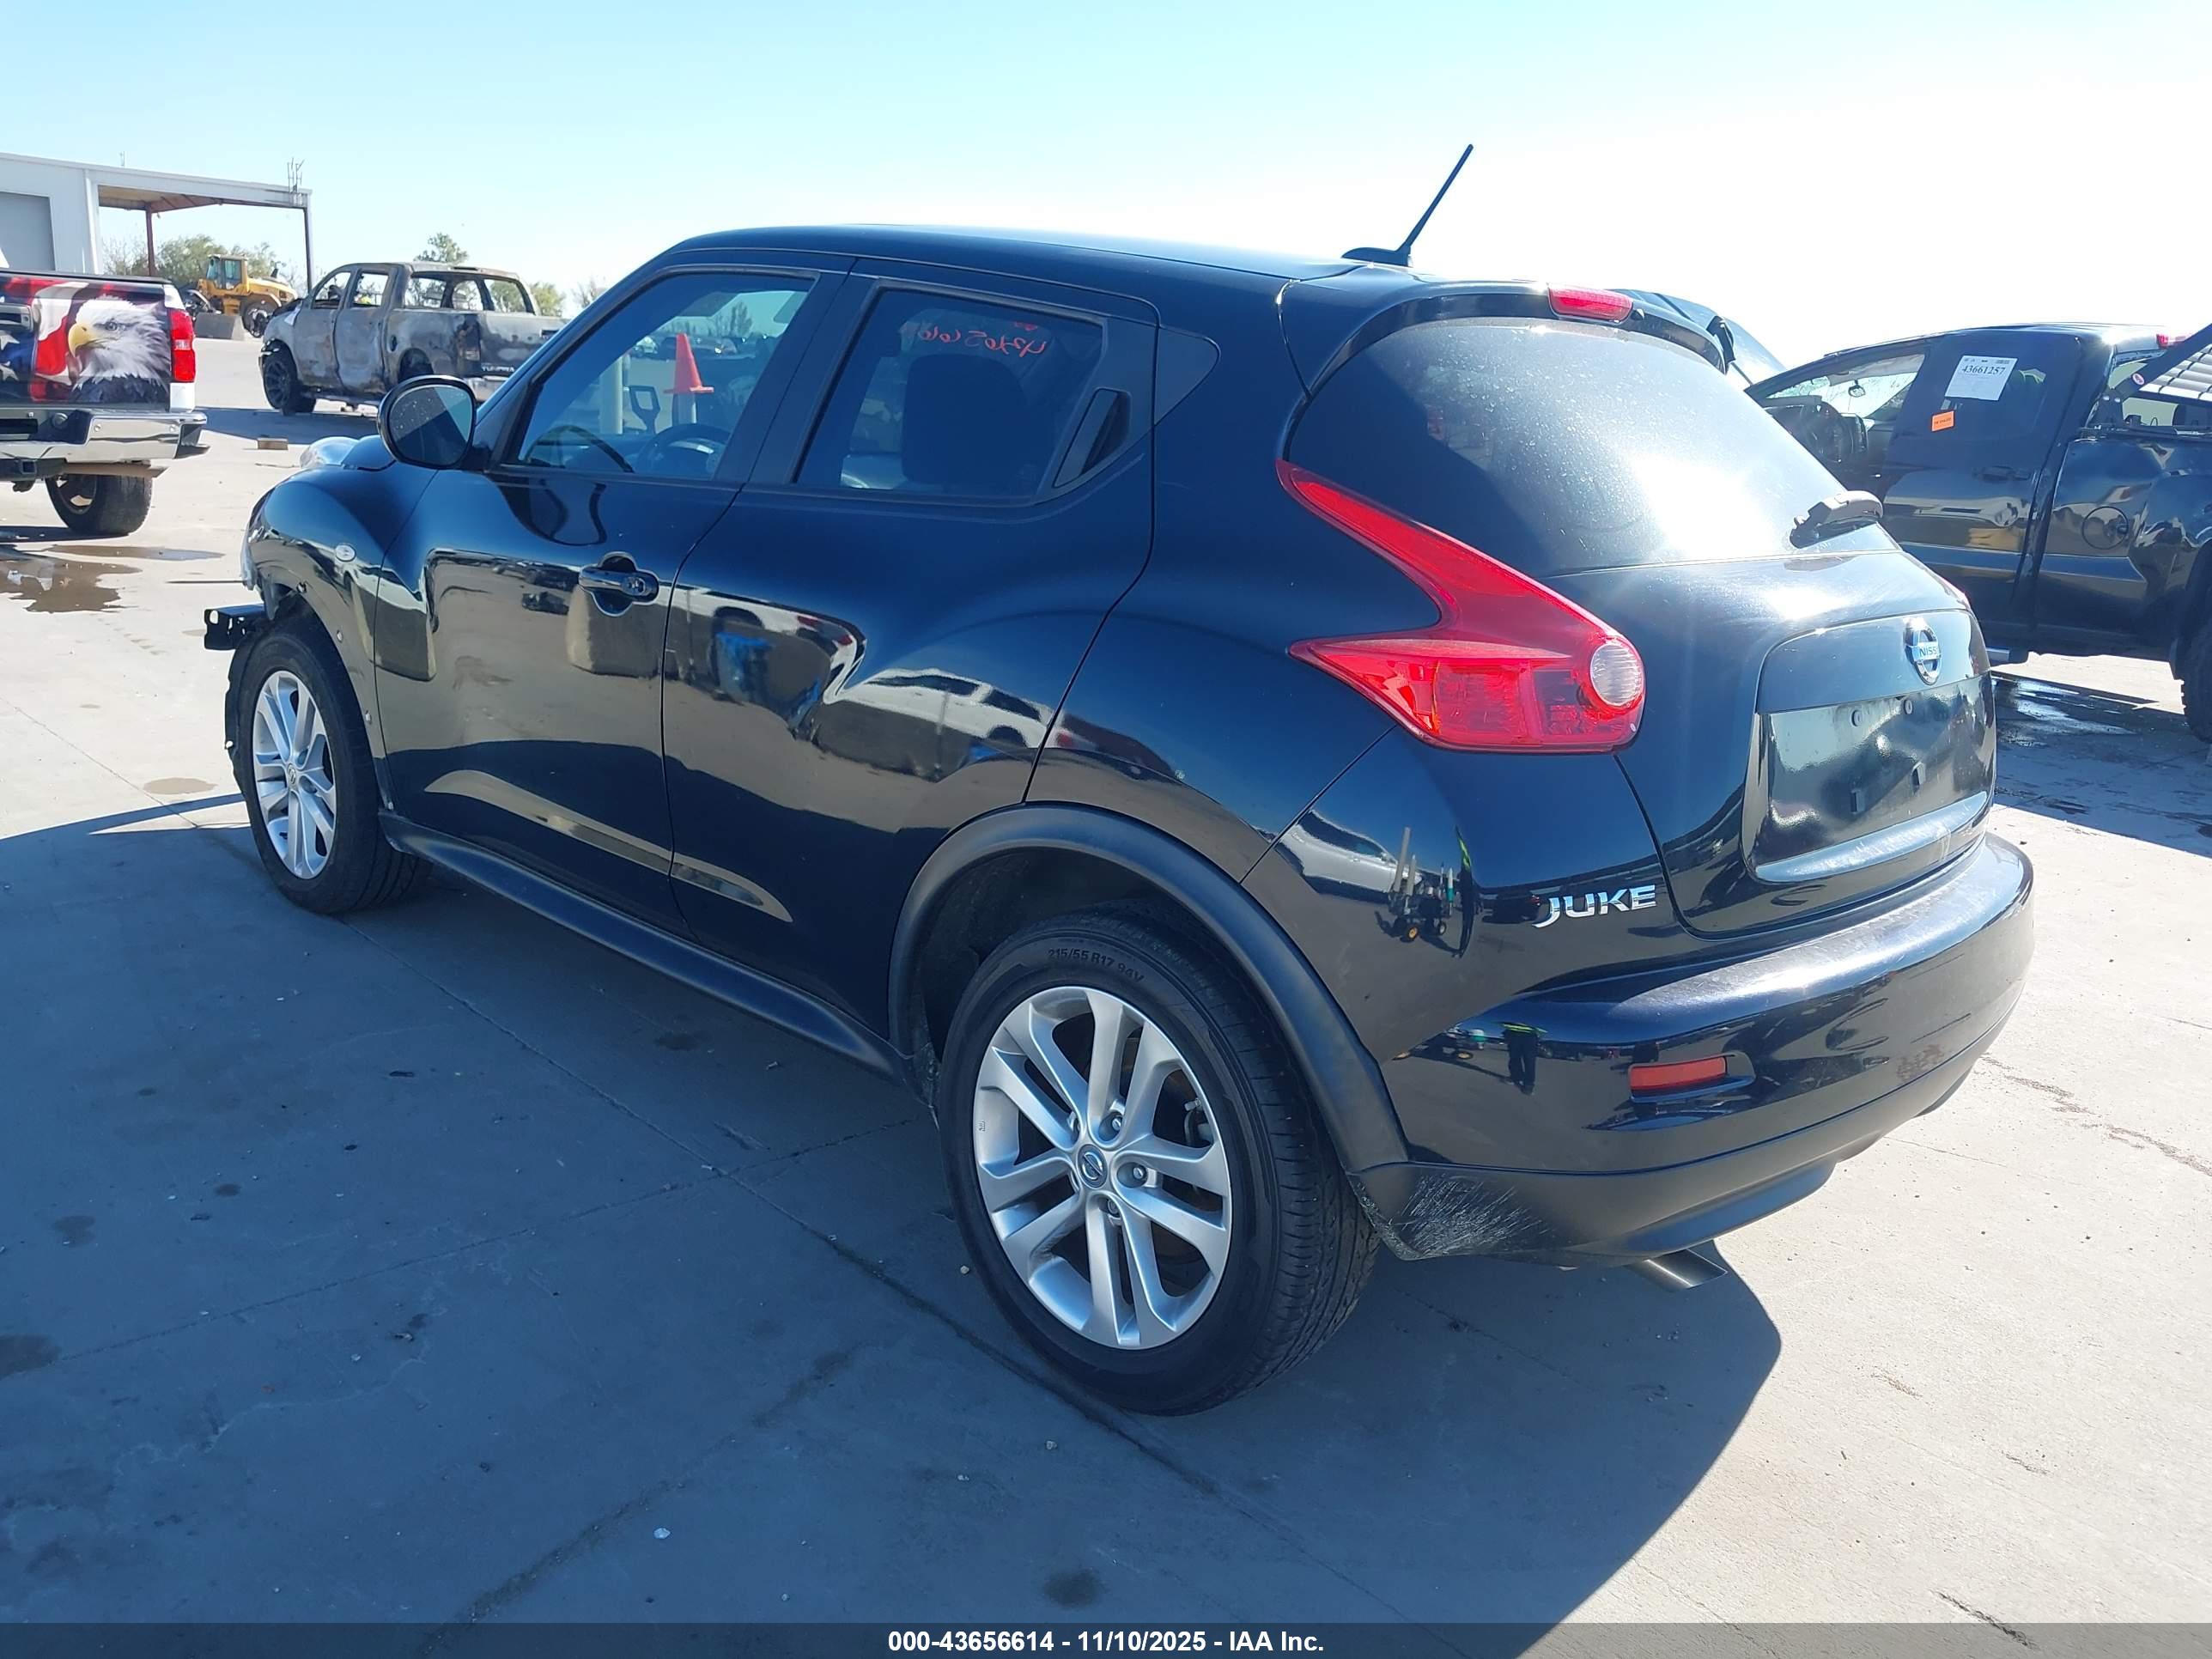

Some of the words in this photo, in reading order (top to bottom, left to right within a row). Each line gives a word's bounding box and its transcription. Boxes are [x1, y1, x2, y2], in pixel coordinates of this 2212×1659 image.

[1961, 364, 2006, 375] 43661257
[1531, 884, 1656, 928] JUKE
[1048, 947, 1090, 961] 215/55
[1091, 952, 1115, 968] R17
